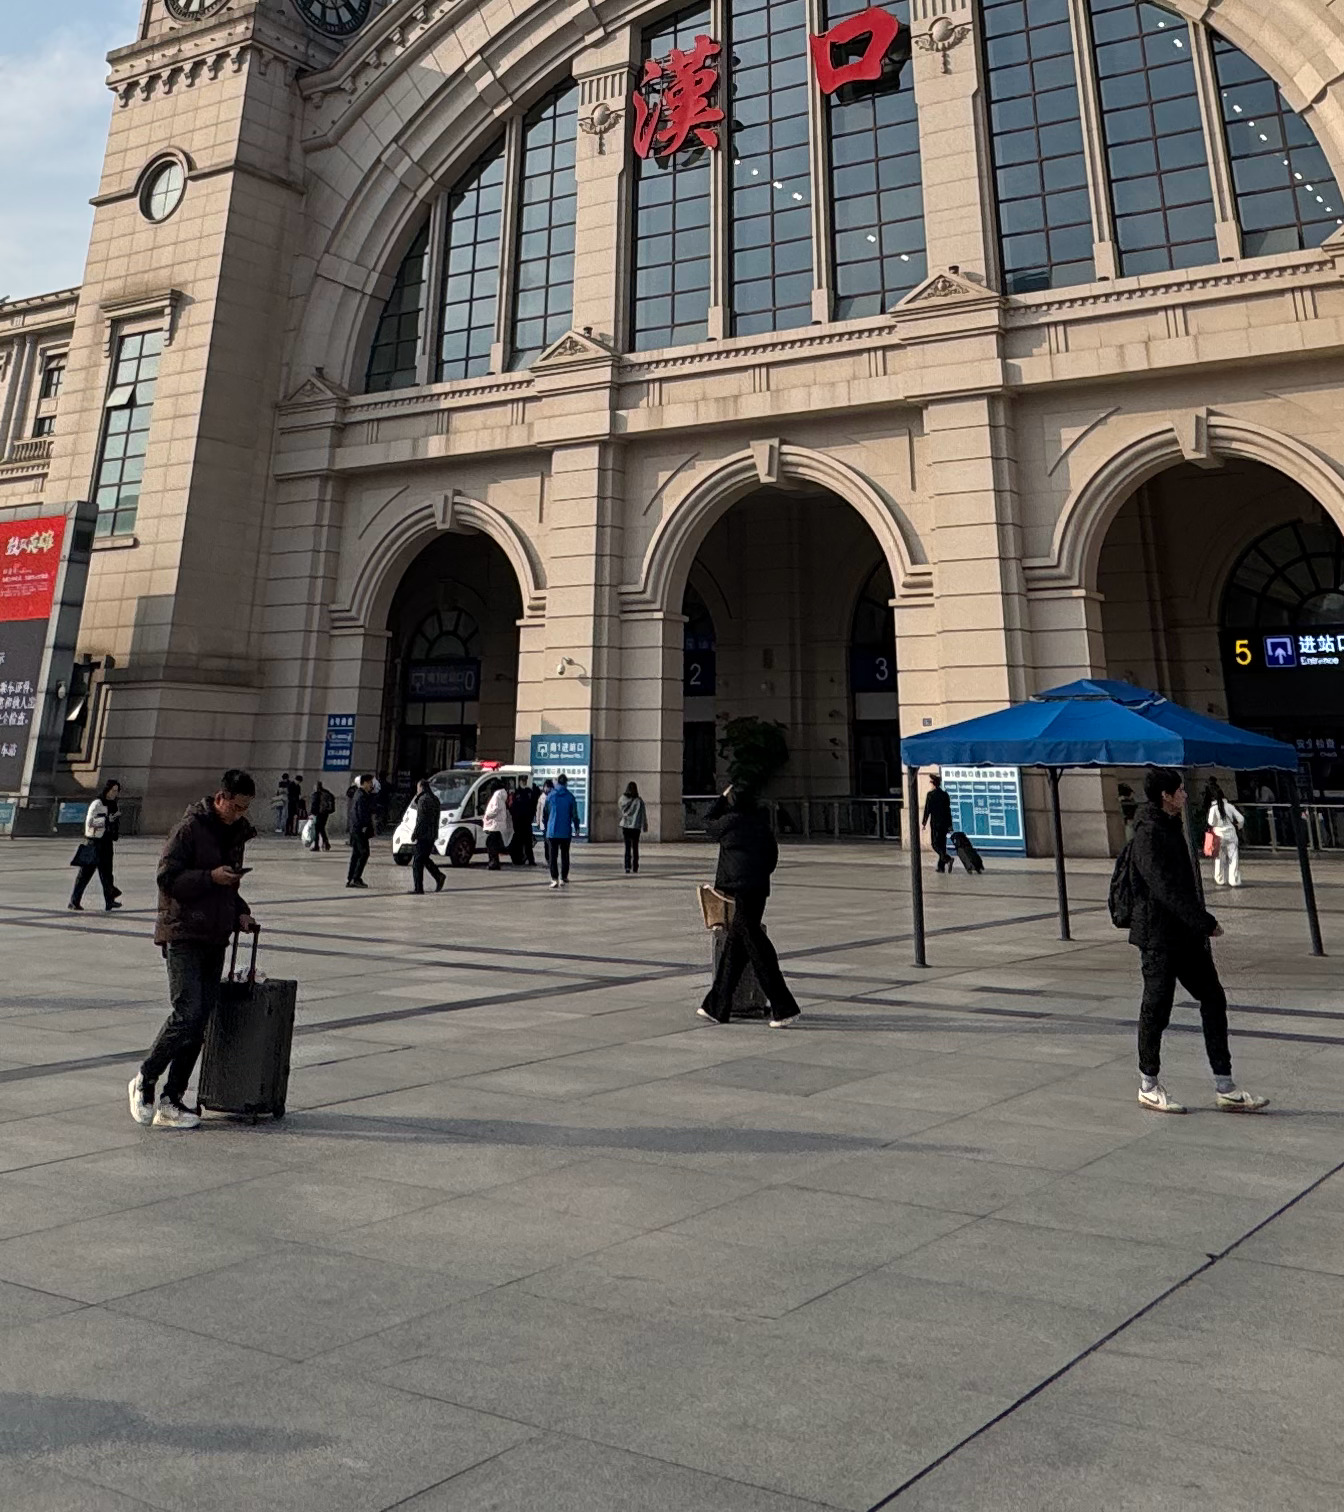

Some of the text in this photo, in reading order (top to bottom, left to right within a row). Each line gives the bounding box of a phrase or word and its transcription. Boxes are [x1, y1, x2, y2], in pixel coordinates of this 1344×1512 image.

[632, 6, 900, 160] 漢口
[1235, 639, 1252, 666] 5
[689, 663, 702, 686] 2
[875, 656, 889, 681] 3
